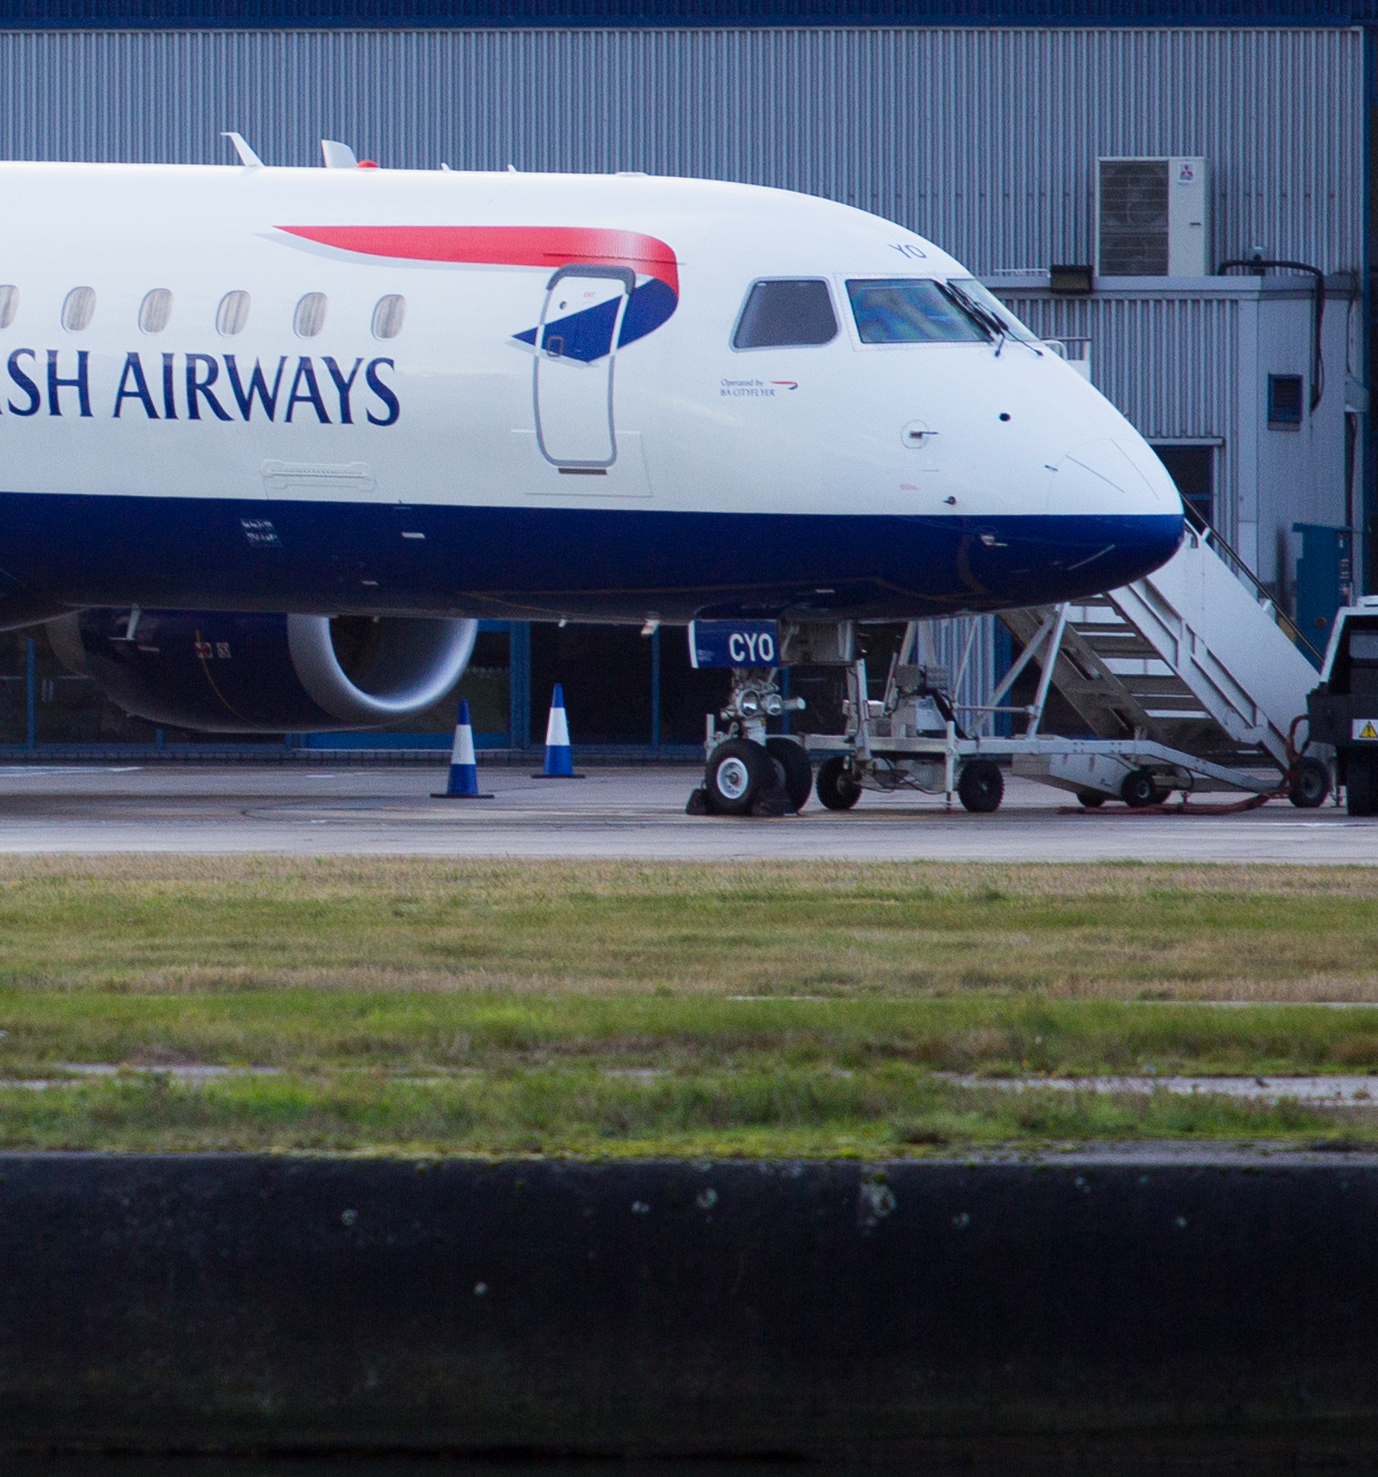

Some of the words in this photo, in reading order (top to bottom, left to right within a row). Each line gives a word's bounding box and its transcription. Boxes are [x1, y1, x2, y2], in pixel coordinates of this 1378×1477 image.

[887, 244, 928, 259] YO
[111, 351, 401, 427] AIRWAYS
[729, 632, 775, 662] CYO
